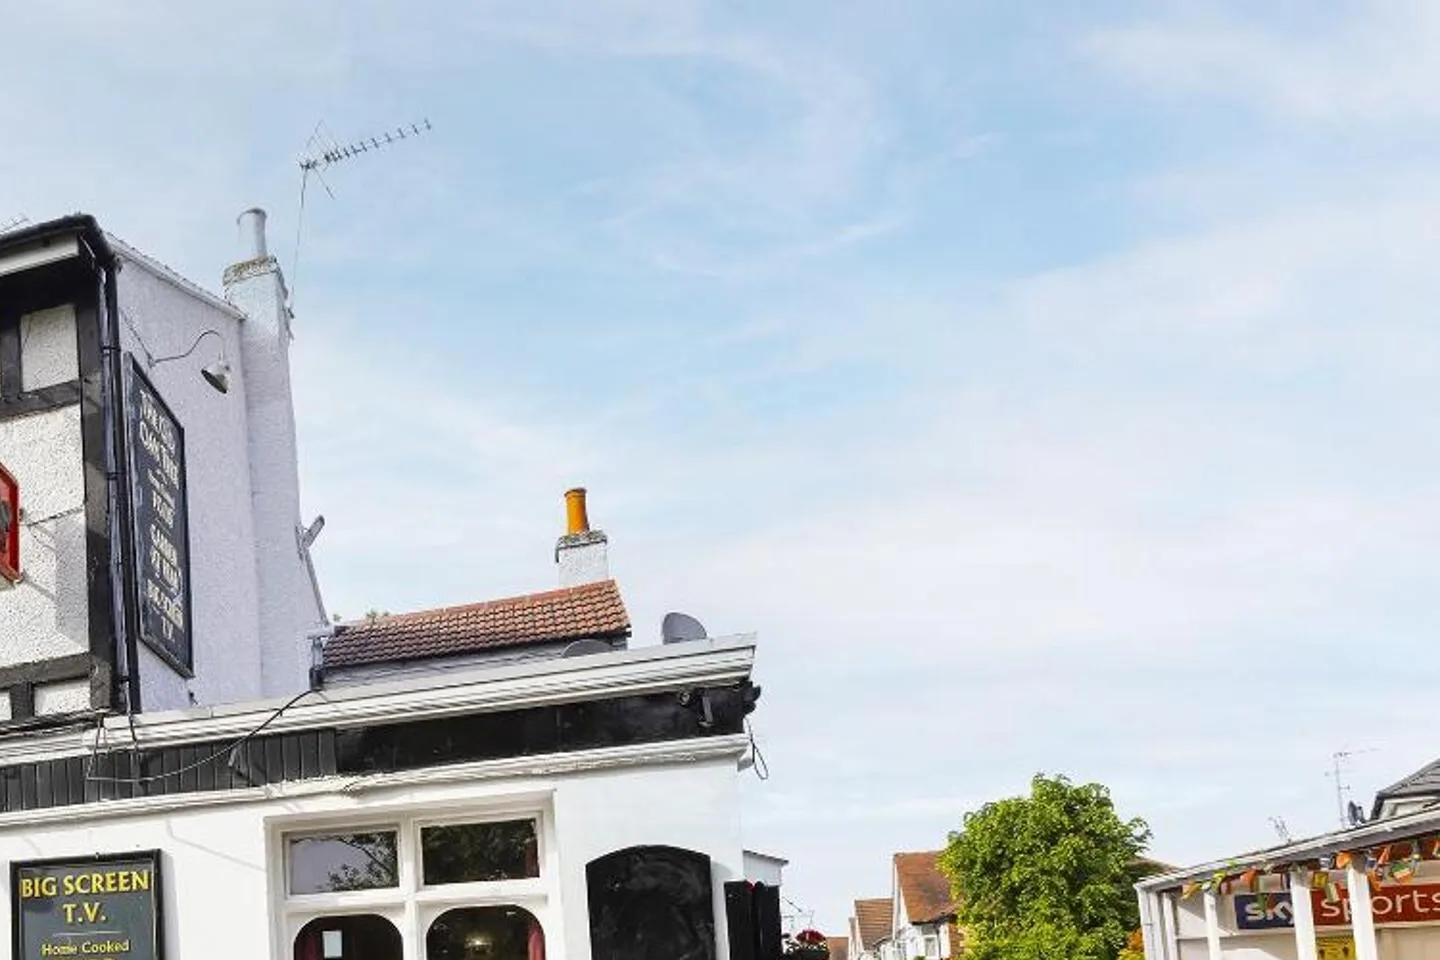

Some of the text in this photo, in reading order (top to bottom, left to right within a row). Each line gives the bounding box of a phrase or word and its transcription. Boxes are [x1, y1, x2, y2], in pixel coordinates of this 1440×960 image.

[21, 869, 150, 898] BIG SCREEN
[62, 901, 107, 924] T.V.
[81, 939, 132, 954] Cooked
